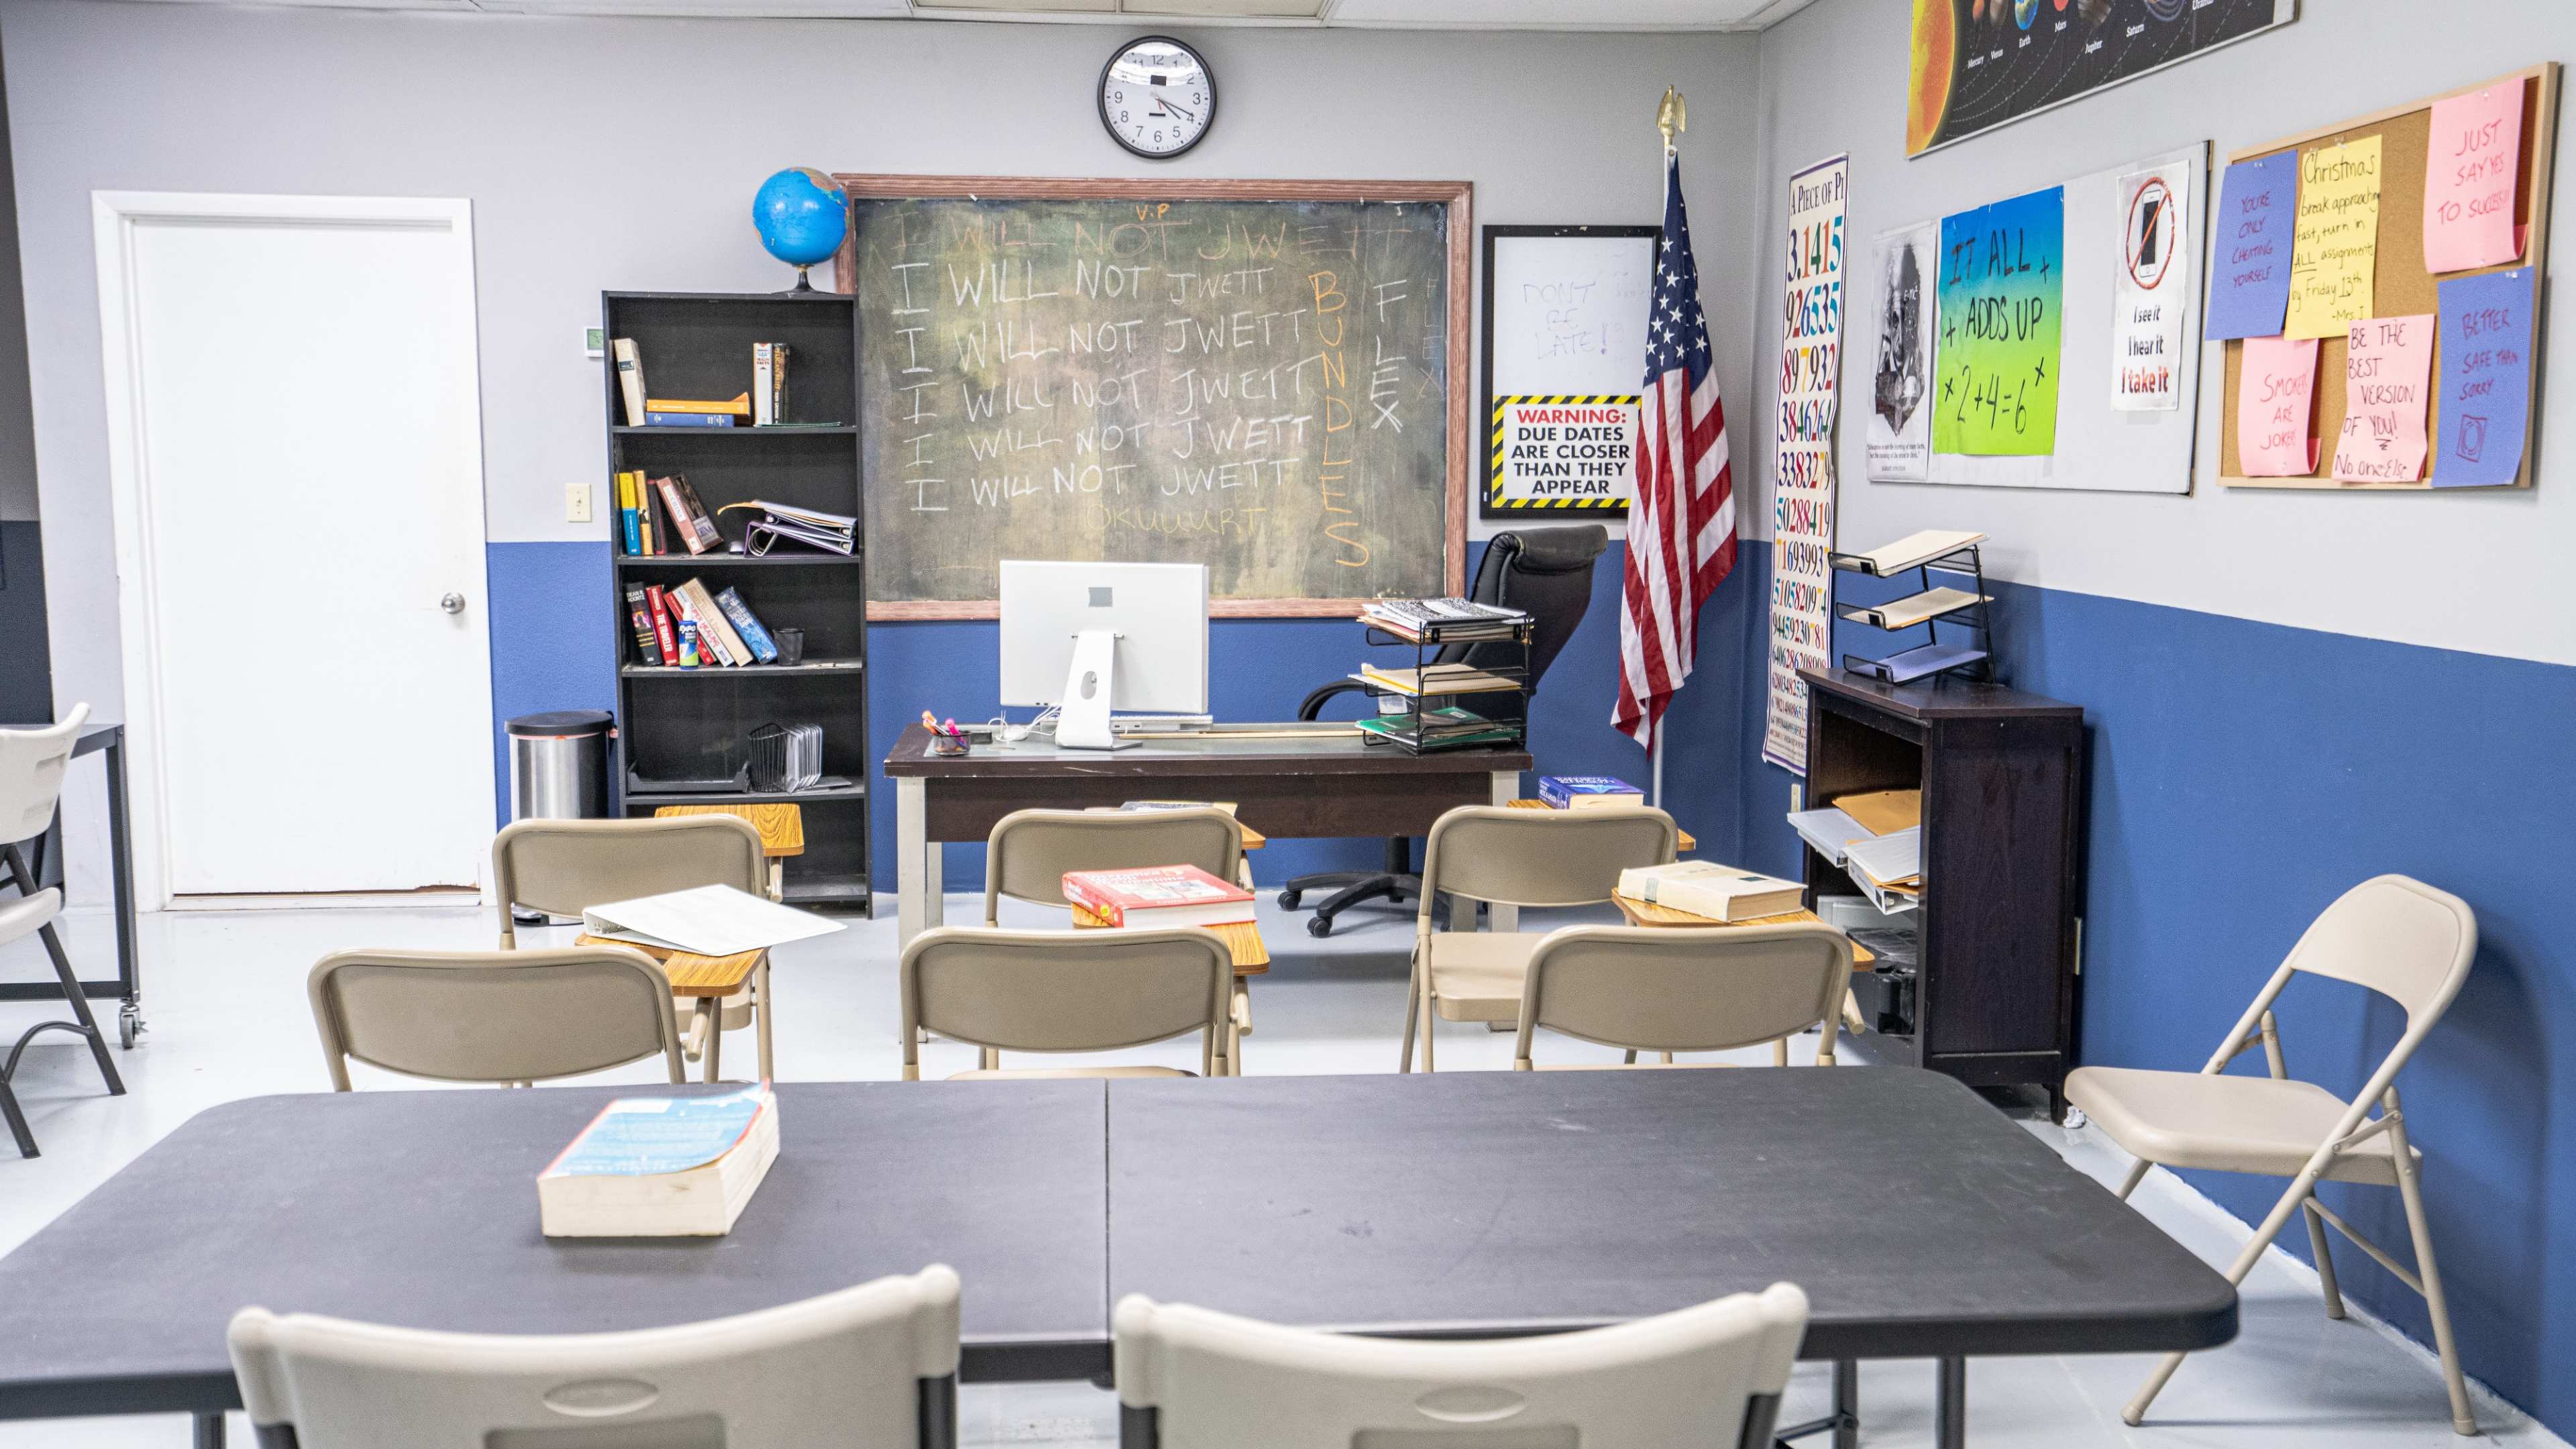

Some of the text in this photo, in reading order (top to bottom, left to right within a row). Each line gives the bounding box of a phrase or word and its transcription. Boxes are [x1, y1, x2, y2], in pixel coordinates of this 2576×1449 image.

[2055, 21, 2067, 32] Mars
[2126, 23, 2145, 38] Saturn
[2019, 35, 2031, 48] Earth
[2085, 40, 2103, 54] Jupiter
[1152, 55, 1164, 65] 12
[1968, 56, 1984, 68] Mercury
[1991, 49, 2003, 60] Venus
[1187, 73, 1195, 85] 2
[1114, 91, 1122, 103] 9
[1193, 93, 1201, 105] 3
[1121, 111, 1128, 123] 8
[1187, 113, 1194, 124] 4
[1136, 126, 1144, 138] 7
[1154, 131, 1162, 143] 6
[1173, 126, 1181, 138] 5
[2455, 119, 2502, 156] JUST
[2304, 152, 2375, 184] Christmas
[2455, 152, 2504, 186] SAY YES
[2302, 195, 2328, 217] break
[2438, 201, 2461, 225] TO
[951, 214, 1058, 252] WILL
[1075, 219, 1191, 260] NOT
[1197, 223, 1412, 260] JWETT
[2239, 216, 2266, 239] ONLY
[2322, 223, 2349, 237] turn
[1787, 215, 1843, 282] 3.1415
[1949, 227, 2031, 286] IT ALL
[2294, 252, 2316, 270] ALL
[892, 259, 1274, 315] I WILL NOT JWETT
[2233, 266, 2271, 288] YOURSELF
[2292, 282, 2301, 313] by
[2306, 276, 2337, 305] Friday
[1785, 281, 1840, 340] 926535
[1966, 297, 2043, 341] ADDS UP
[2133, 304, 2161, 323] I see it
[896, 309, 1306, 374] I WILL NOT JWETT
[2129, 335, 2163, 356] I hear it
[2351, 322, 2406, 350] BE THE
[1782, 343, 1835, 394] 897932
[2348, 358, 2382, 380] BEST
[2462, 350, 2491, 374] SAFE
[899, 354, 1322, 425] I WILL NOT JWETT
[2122, 366, 2169, 394] I take it
[2459, 378, 2493, 400] SORRY
[2361, 384, 2415, 405] VERSION
[1517, 409, 1626, 424] WARNING:
[1780, 398, 1831, 443] 3846264
[2273, 405, 2293, 424] ARE
[1518, 427, 1623, 441] DUE DATES
[2344, 417, 2361, 437] OF
[903, 415, 1313, 468] I WILL NOT JWETT
[1511, 445, 1630, 460] ARE CLOSER
[1514, 463, 1627, 477] THAN THEY
[1778, 451, 1830, 490] 3383279
[2334, 454, 2353, 475] No
[905, 458, 1300, 512] I WILL NOT JWETT
[1532, 480, 1610, 494] APPEAR
[1776, 497, 1830, 537] 50288419
[1776, 539, 1829, 578] 716939937
[1774, 578, 1827, 617] 5105820974
[1772, 612, 1825, 650] 94459230781
